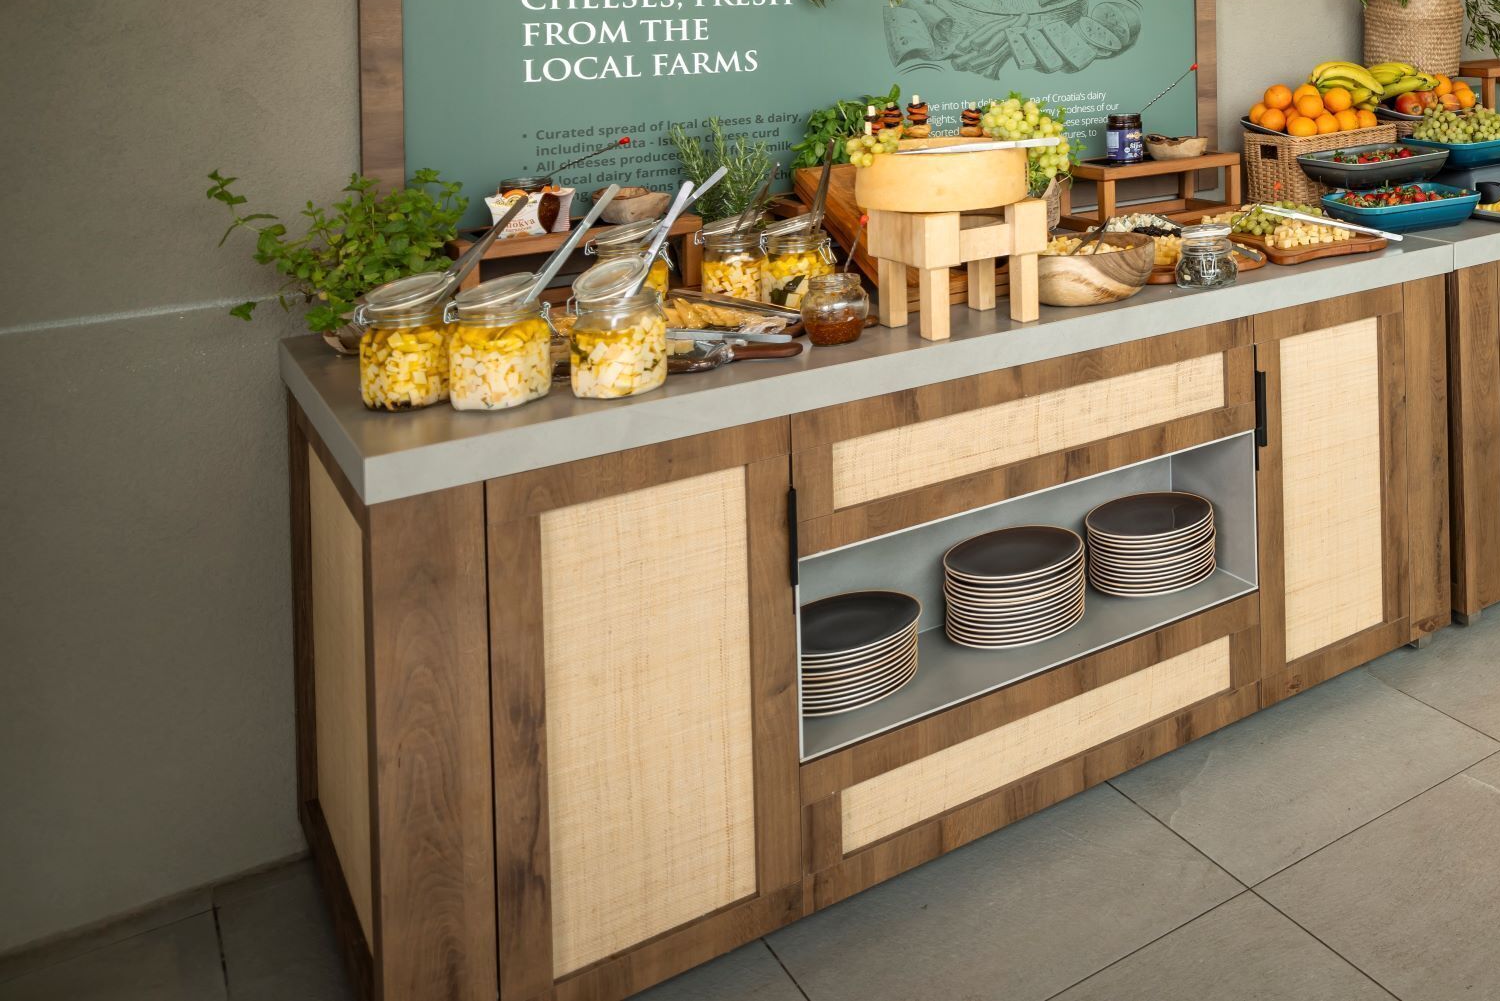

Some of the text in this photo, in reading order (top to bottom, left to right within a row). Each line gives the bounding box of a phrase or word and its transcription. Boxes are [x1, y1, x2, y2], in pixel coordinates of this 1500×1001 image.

[522, 18, 710, 47] FROM THE
[523, 50, 758, 83] LOCAL FARMS
[1052, 92, 1086, 103] Croatia's
[1087, 91, 1107, 101] dairy
[927, 102, 940, 112] ive
[942, 101, 959, 110] into
[1097, 102, 1105, 112] of
[1106, 103, 1119, 111] our
[536, 126, 594, 141] Curated
[598, 122, 646, 138] spread
[650, 121, 664, 132] of
[755, 114, 764, 124] &
[767, 112, 802, 124] dairy,
[927, 114, 957, 127] elights,
[1088, 129, 1097, 137] to
[536, 142, 604, 157] including
[752, 127, 779, 139] curd
[536, 160, 555, 173] All
[559, 172, 592, 186] local
[596, 170, 632, 183] dairy
